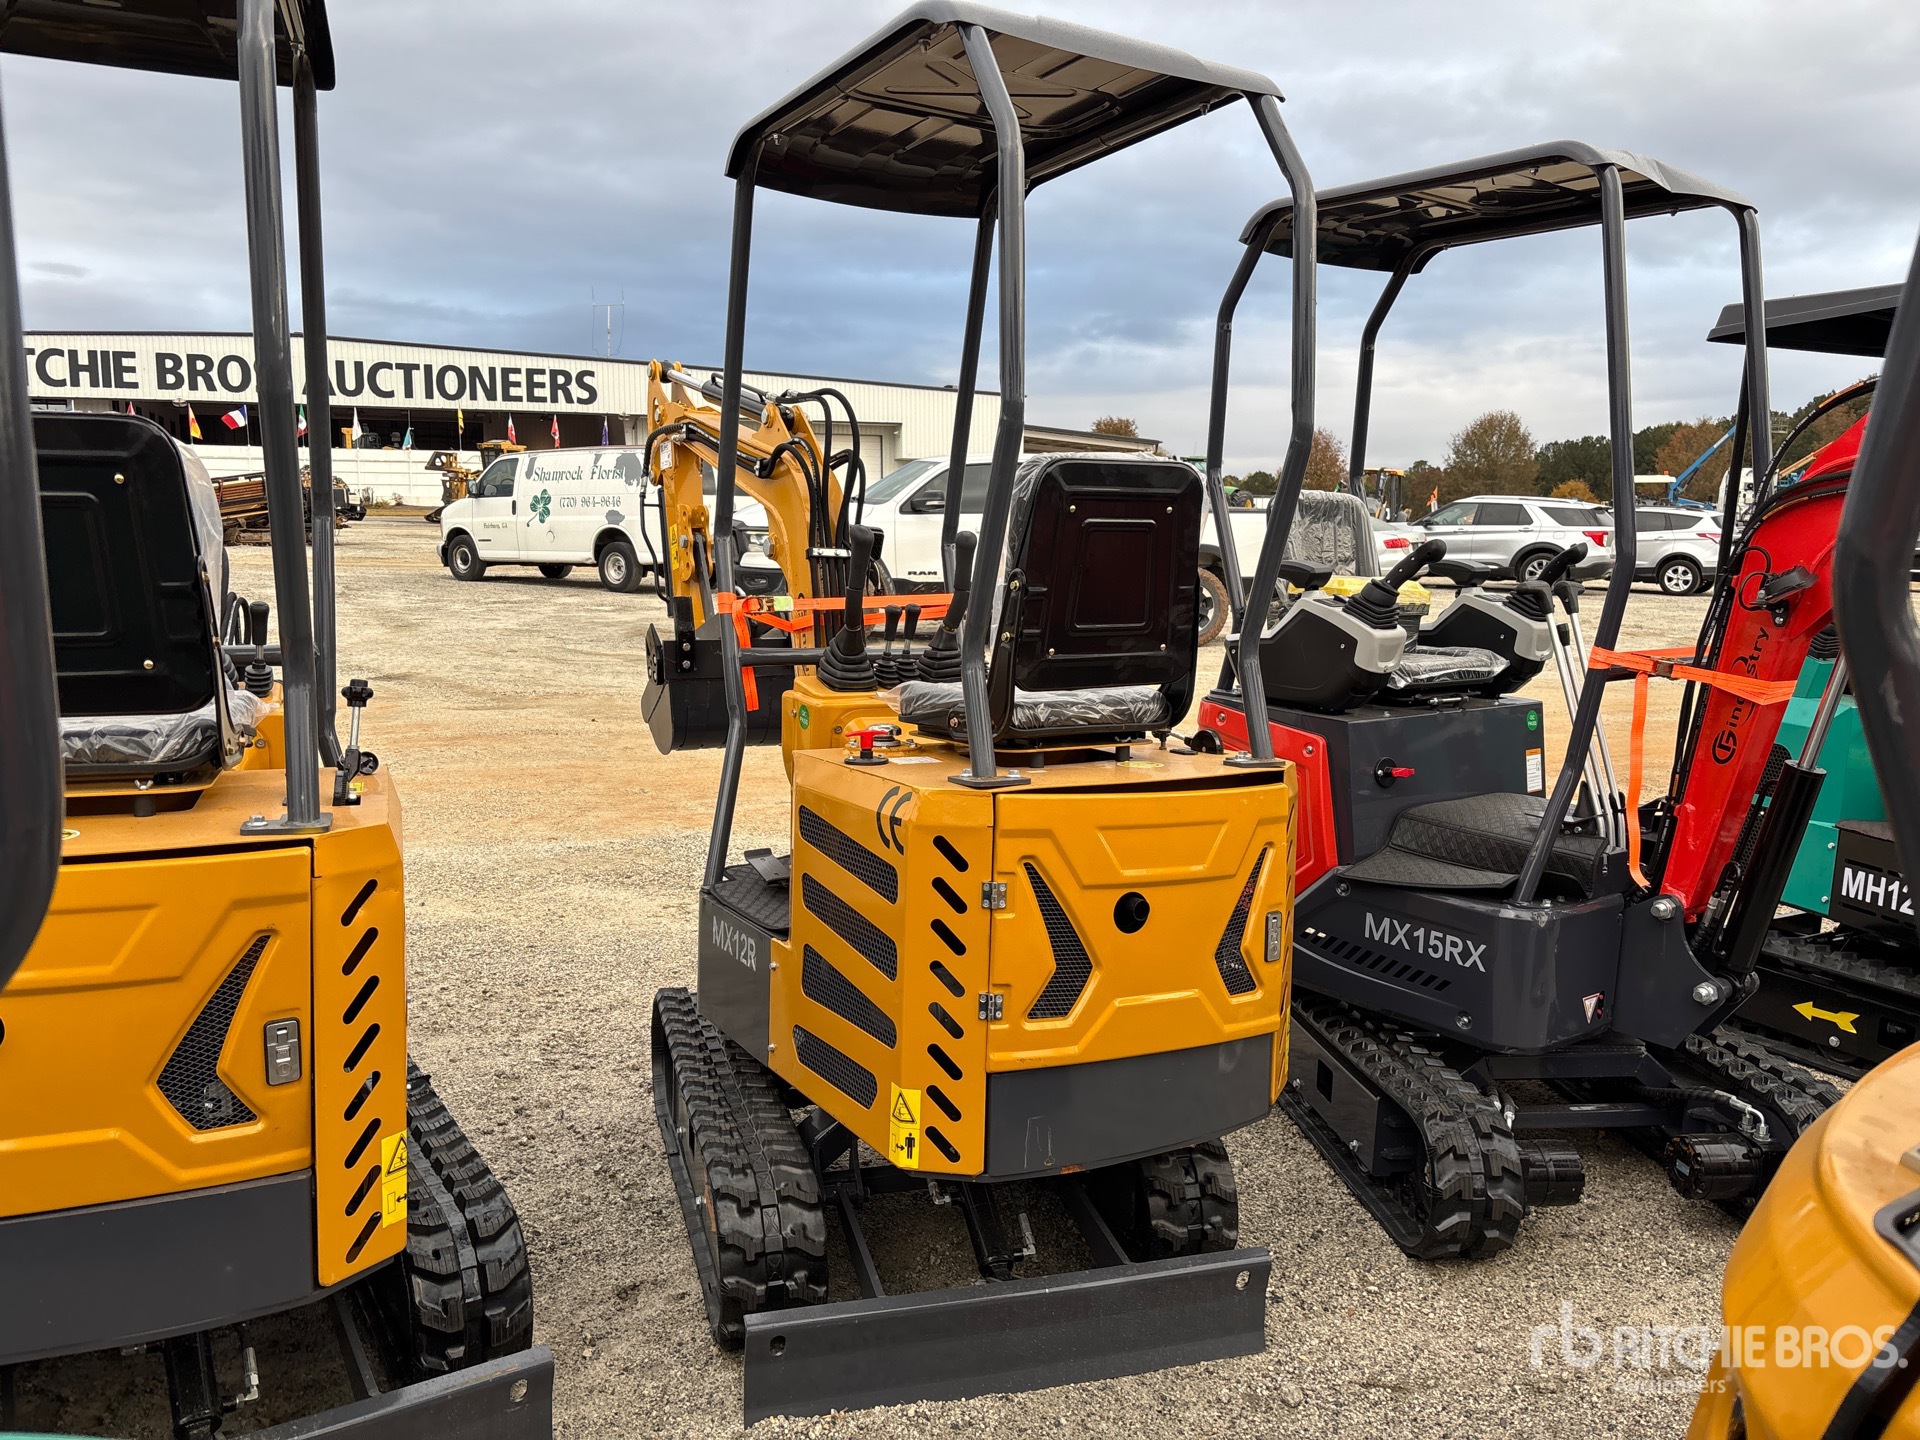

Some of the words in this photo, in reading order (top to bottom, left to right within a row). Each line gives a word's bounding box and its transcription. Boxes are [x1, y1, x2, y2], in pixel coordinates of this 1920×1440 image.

[155, 352, 257, 393] BRO
[533, 466, 583, 483] Shamrock
[590, 464, 625, 480] Florist
[559, 496, 577, 508] (770)
[580, 496, 622, 508] 964-9646
[712, 915, 757, 972] MX12R
[1364, 911, 1487, 973] MX15RX
